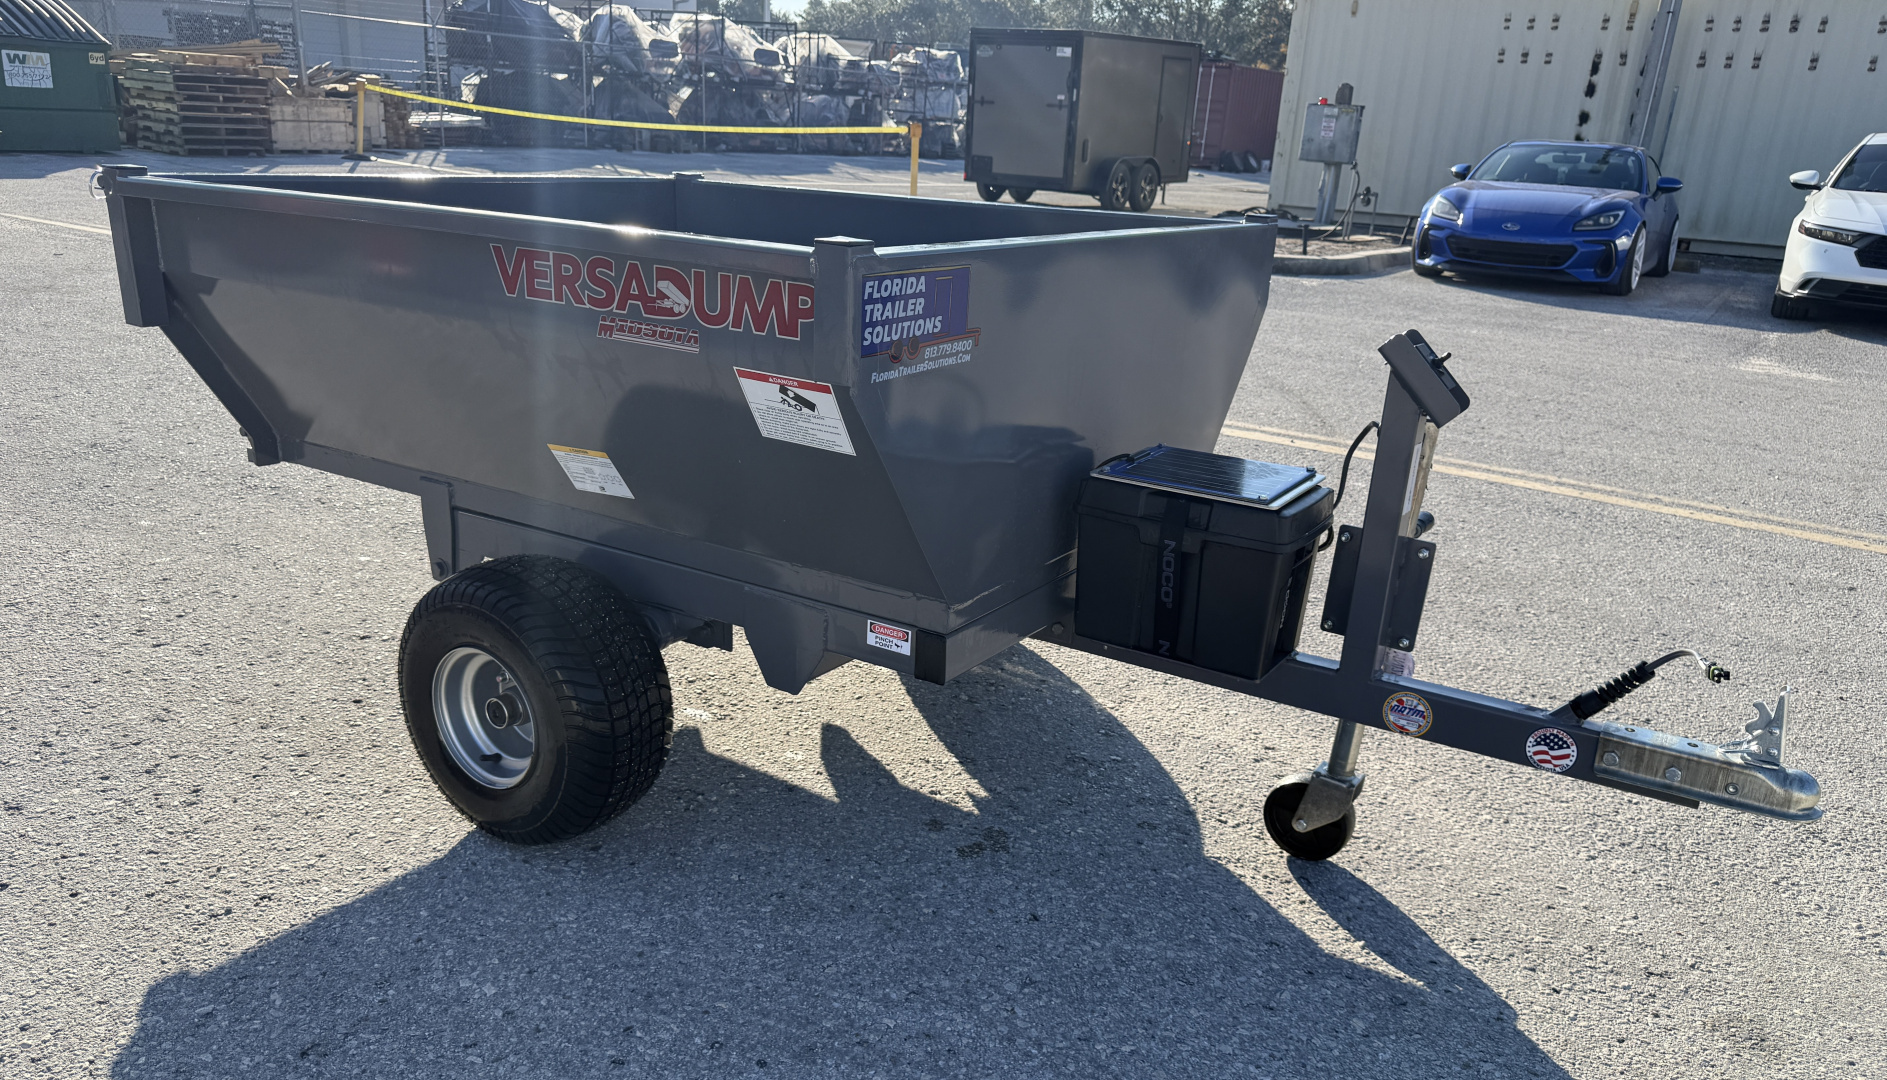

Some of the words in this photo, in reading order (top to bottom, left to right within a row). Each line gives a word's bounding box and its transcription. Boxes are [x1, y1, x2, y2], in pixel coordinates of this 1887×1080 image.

[89, 53, 105, 63] 6yd
[490, 243, 815, 341] VERSADUMP
[864, 276, 926, 300] FLORIDA
[864, 298, 925, 323] TRAILER
[597, 315, 699, 346] MIDSOTA
[863, 315, 943, 346] SOLUTIONS
[924, 340, 973, 359] 813.779.8400
[875, 625, 903, 639] DANGER
[875, 635, 893, 644] PINCH
[875, 641, 893, 649] POINT
[1531, 728, 1555, 740] PROUDLY
[1556, 730, 1571, 741] MADE
[1559, 763, 1570, 771] USA
